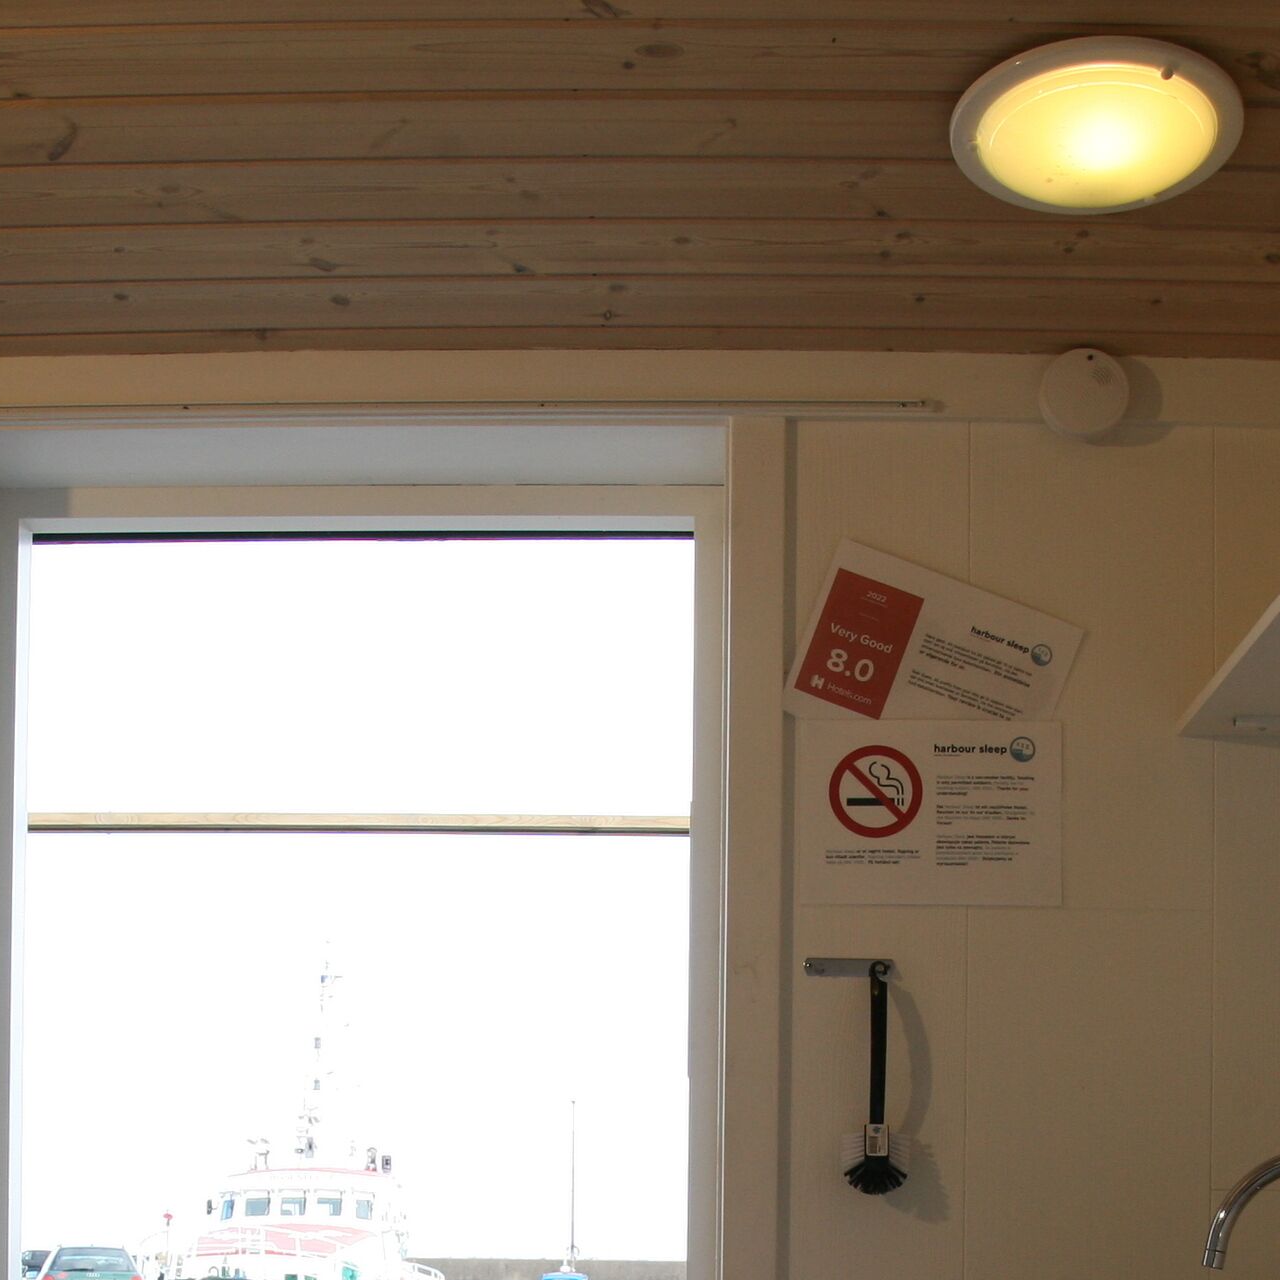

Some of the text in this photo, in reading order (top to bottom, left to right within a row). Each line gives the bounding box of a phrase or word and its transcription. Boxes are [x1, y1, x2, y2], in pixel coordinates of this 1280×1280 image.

[830, 621, 894, 654] Very Good
[971, 625, 1030, 655] harbour sleep
[825, 648, 875, 683] 8.0
[933, 743, 1008, 756] harbour sleep
